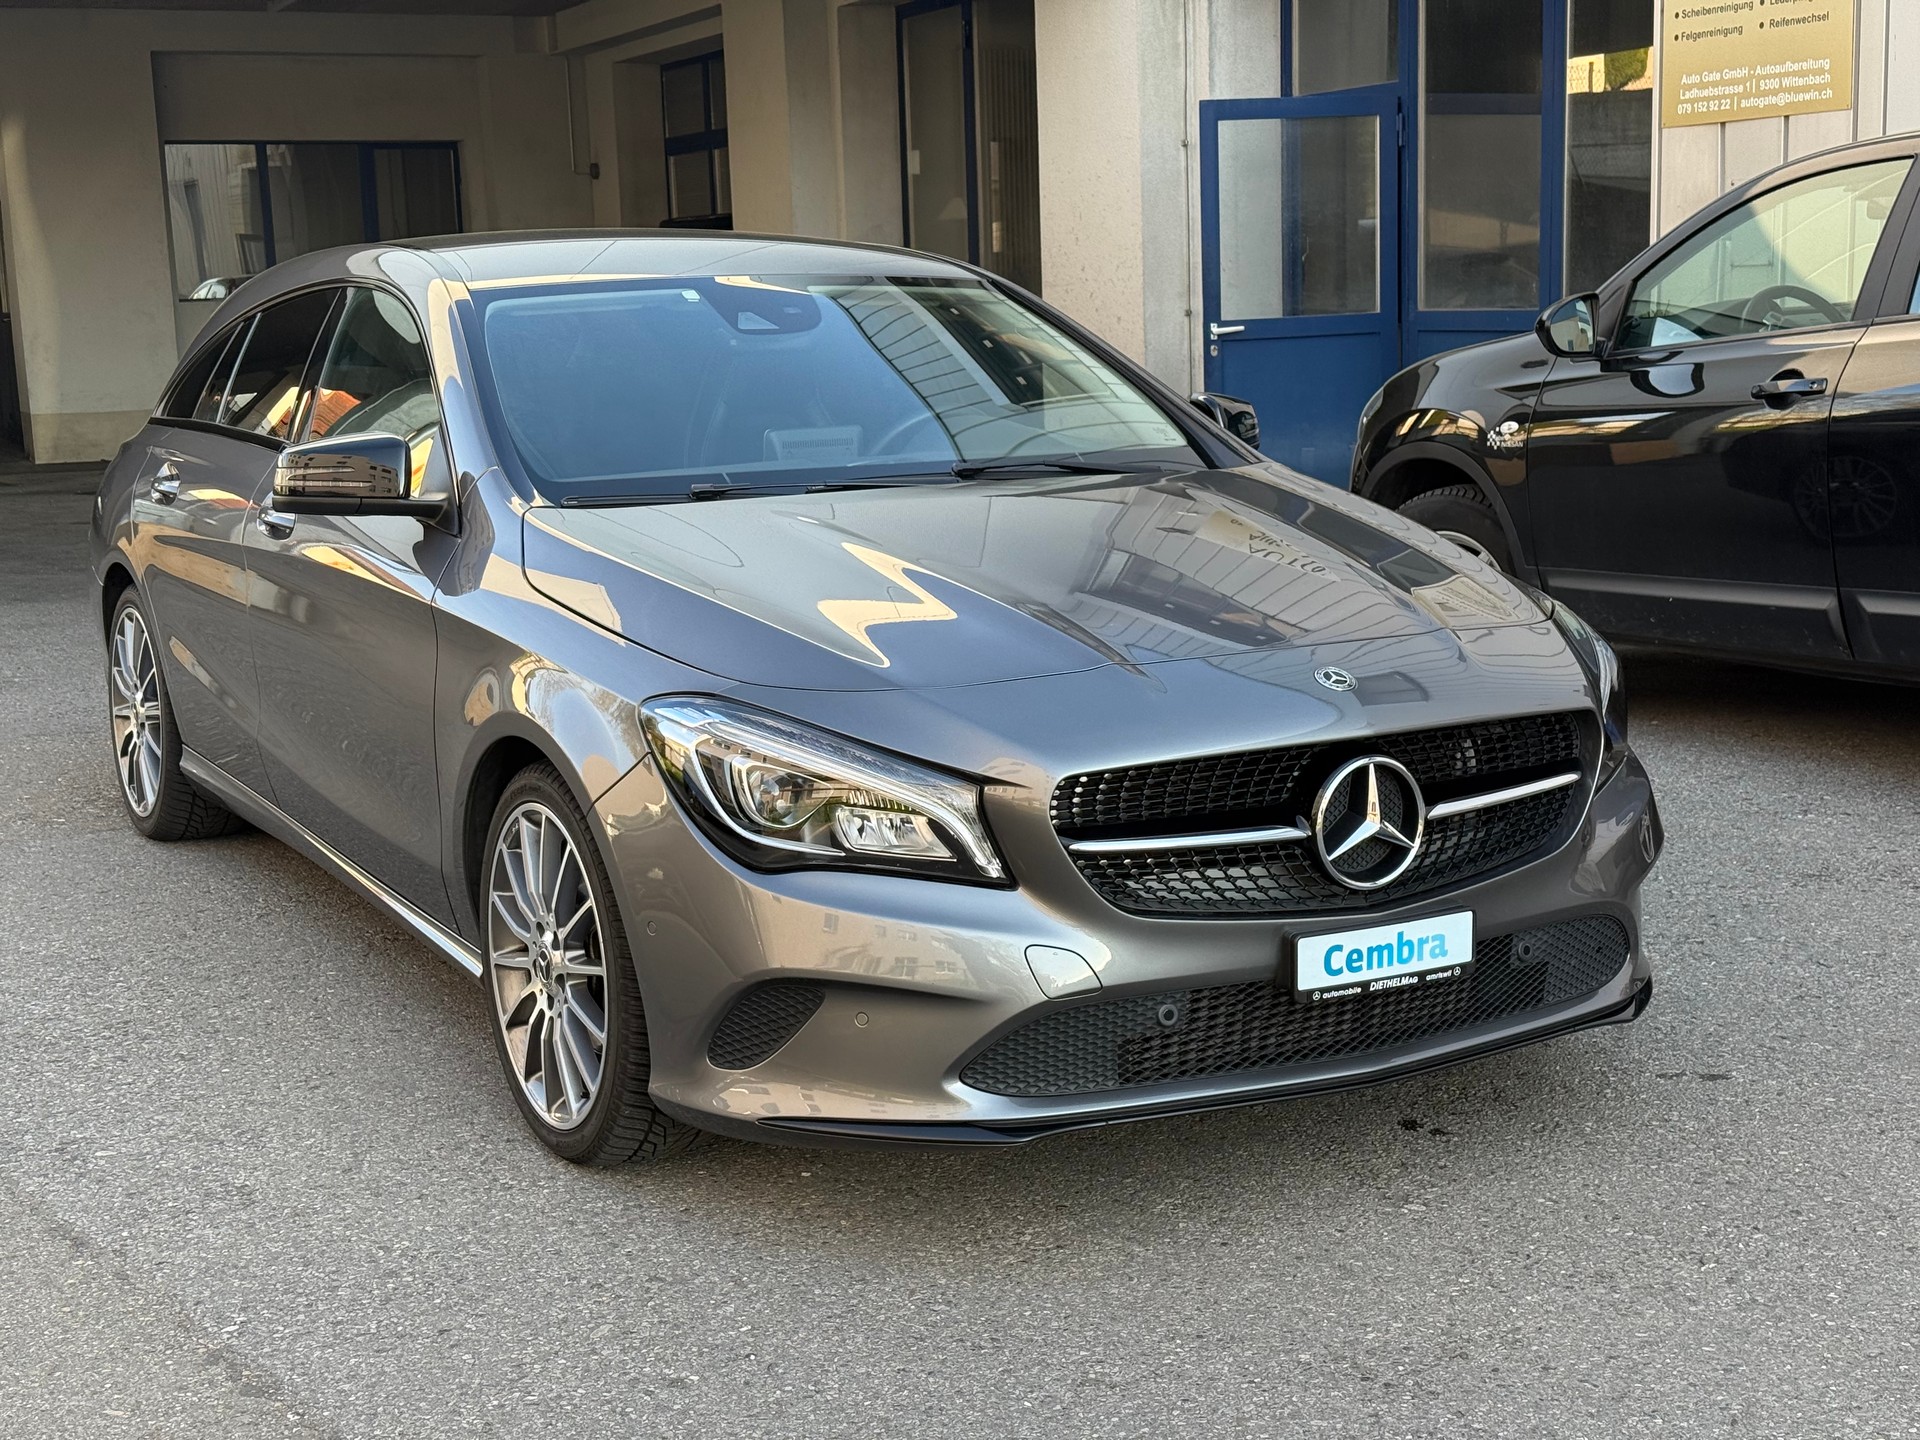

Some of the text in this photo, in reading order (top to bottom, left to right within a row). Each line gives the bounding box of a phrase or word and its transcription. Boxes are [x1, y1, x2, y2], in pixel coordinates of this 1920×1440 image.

[1681, 0, 1754, 19] Scheibenreinigung
[1769, 11, 1830, 29] Reifenwechsel
[1681, 24, 1744, 42] Felgenreinigung
[1681, 74, 1701, 85] Auto
[1702, 70, 1721, 82] Gate
[1722, 67, 1749, 80] GmbH
[1755, 58, 1830, 76] Autoaufbereitung
[1680, 84, 1744, 99] Ladhuebstrasse
[1759, 78, 1780, 91] 9300
[1781, 73, 1831, 89] Wittenbach
[1677, 103, 1692, 115] 079
[1693, 101, 1708, 113] 152
[1708, 100, 1719, 112] 92
[1720, 98, 1731, 111] 22
[1740, 89, 1833, 107] autogate@bluewin.ch
[1324, 931, 1448, 977] Cembra
[1322, 988, 1362, 999] automobile
